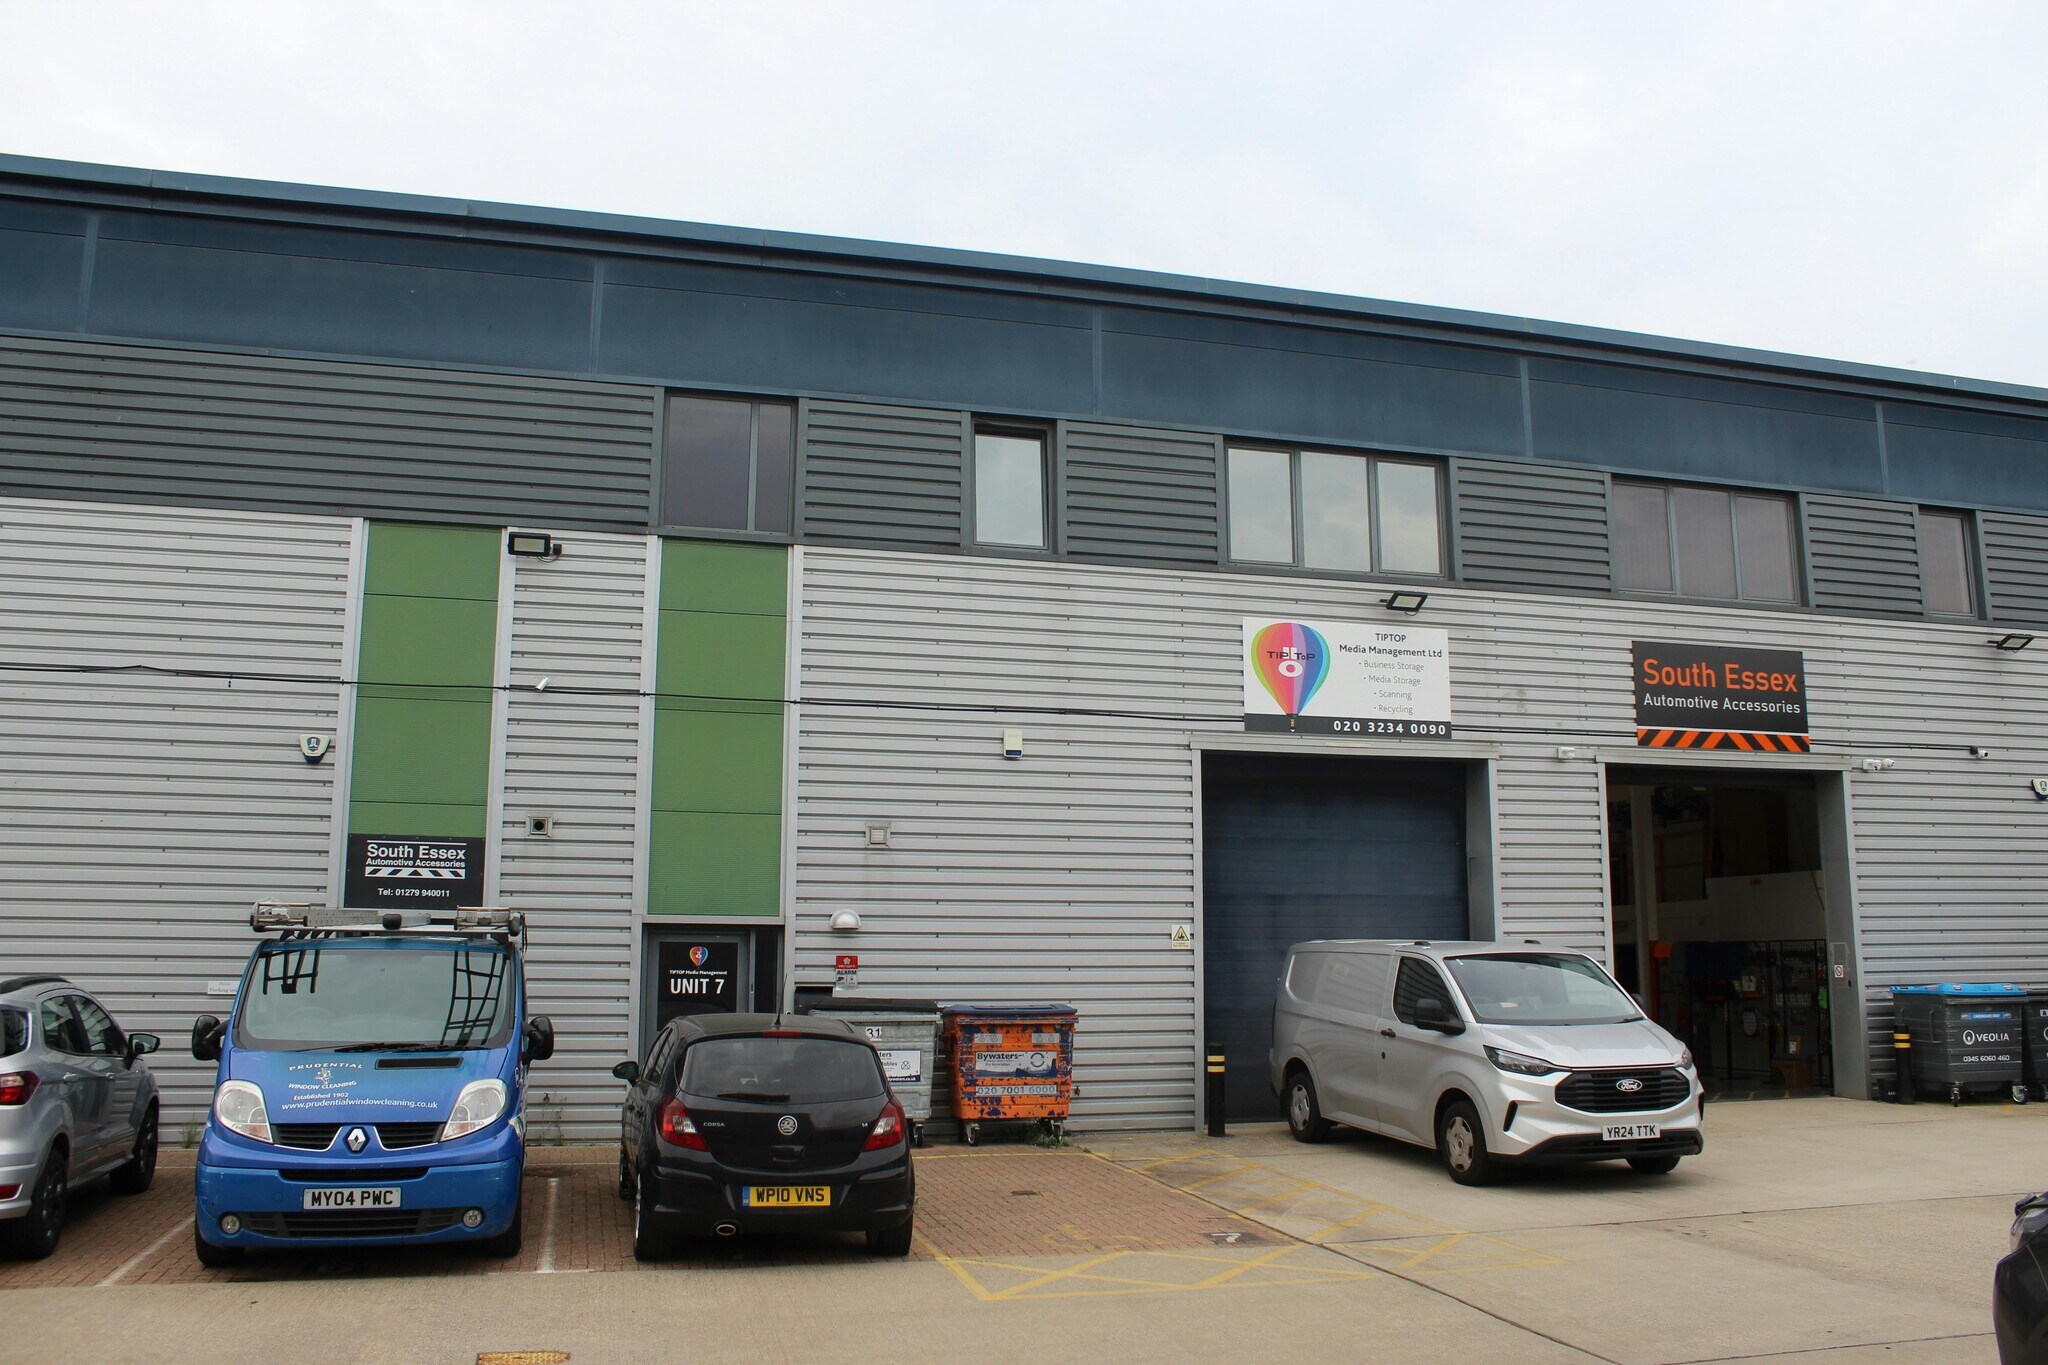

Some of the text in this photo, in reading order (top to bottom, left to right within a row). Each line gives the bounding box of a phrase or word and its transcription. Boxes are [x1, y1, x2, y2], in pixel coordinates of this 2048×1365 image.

[1375, 632, 1406, 642] TIPTOP
[1266, 651, 1288, 659] TIP
[1339, 644, 1442, 658] Media Management Ltd
[1364, 660, 1424, 672] Business Storage
[1368, 674, 1421, 686] Media Storage
[1643, 658, 1798, 692] South Essex
[1378, 689, 1412, 701] Scanning
[1643, 692, 1800, 714] Automotive Accessories
[1378, 704, 1414, 716] Recycling
[1333, 720, 1446, 735] 020 3234 0090
[367, 844, 466, 860] South Essex
[366, 858, 466, 868] Automotive Accessories
[378, 888, 450, 897] Tel: 01279 940011
[670, 978, 725, 994] UNIT 7
[866, 1028, 881, 1039] 31
[1976, 1033, 2010, 1042] VEOLIA
[976, 1053, 1018, 1061] Bywaters
[288, 1062, 363, 1071] PRUDENTIAL
[322, 1080, 357, 1090] CLEANING
[978, 1085, 1055, 1095] 020 7001 6000
[1620, 1080, 1638, 1090] Ford
[294, 1093, 331, 1101] Established
[282, 1098, 438, 1110] www.prudentialwindowcleaning.co.uk
[1607, 1125, 1656, 1138] YR24 TTK
[311, 1190, 394, 1207] MY04 PWC
[756, 1188, 824, 1202] WP10 VNS
